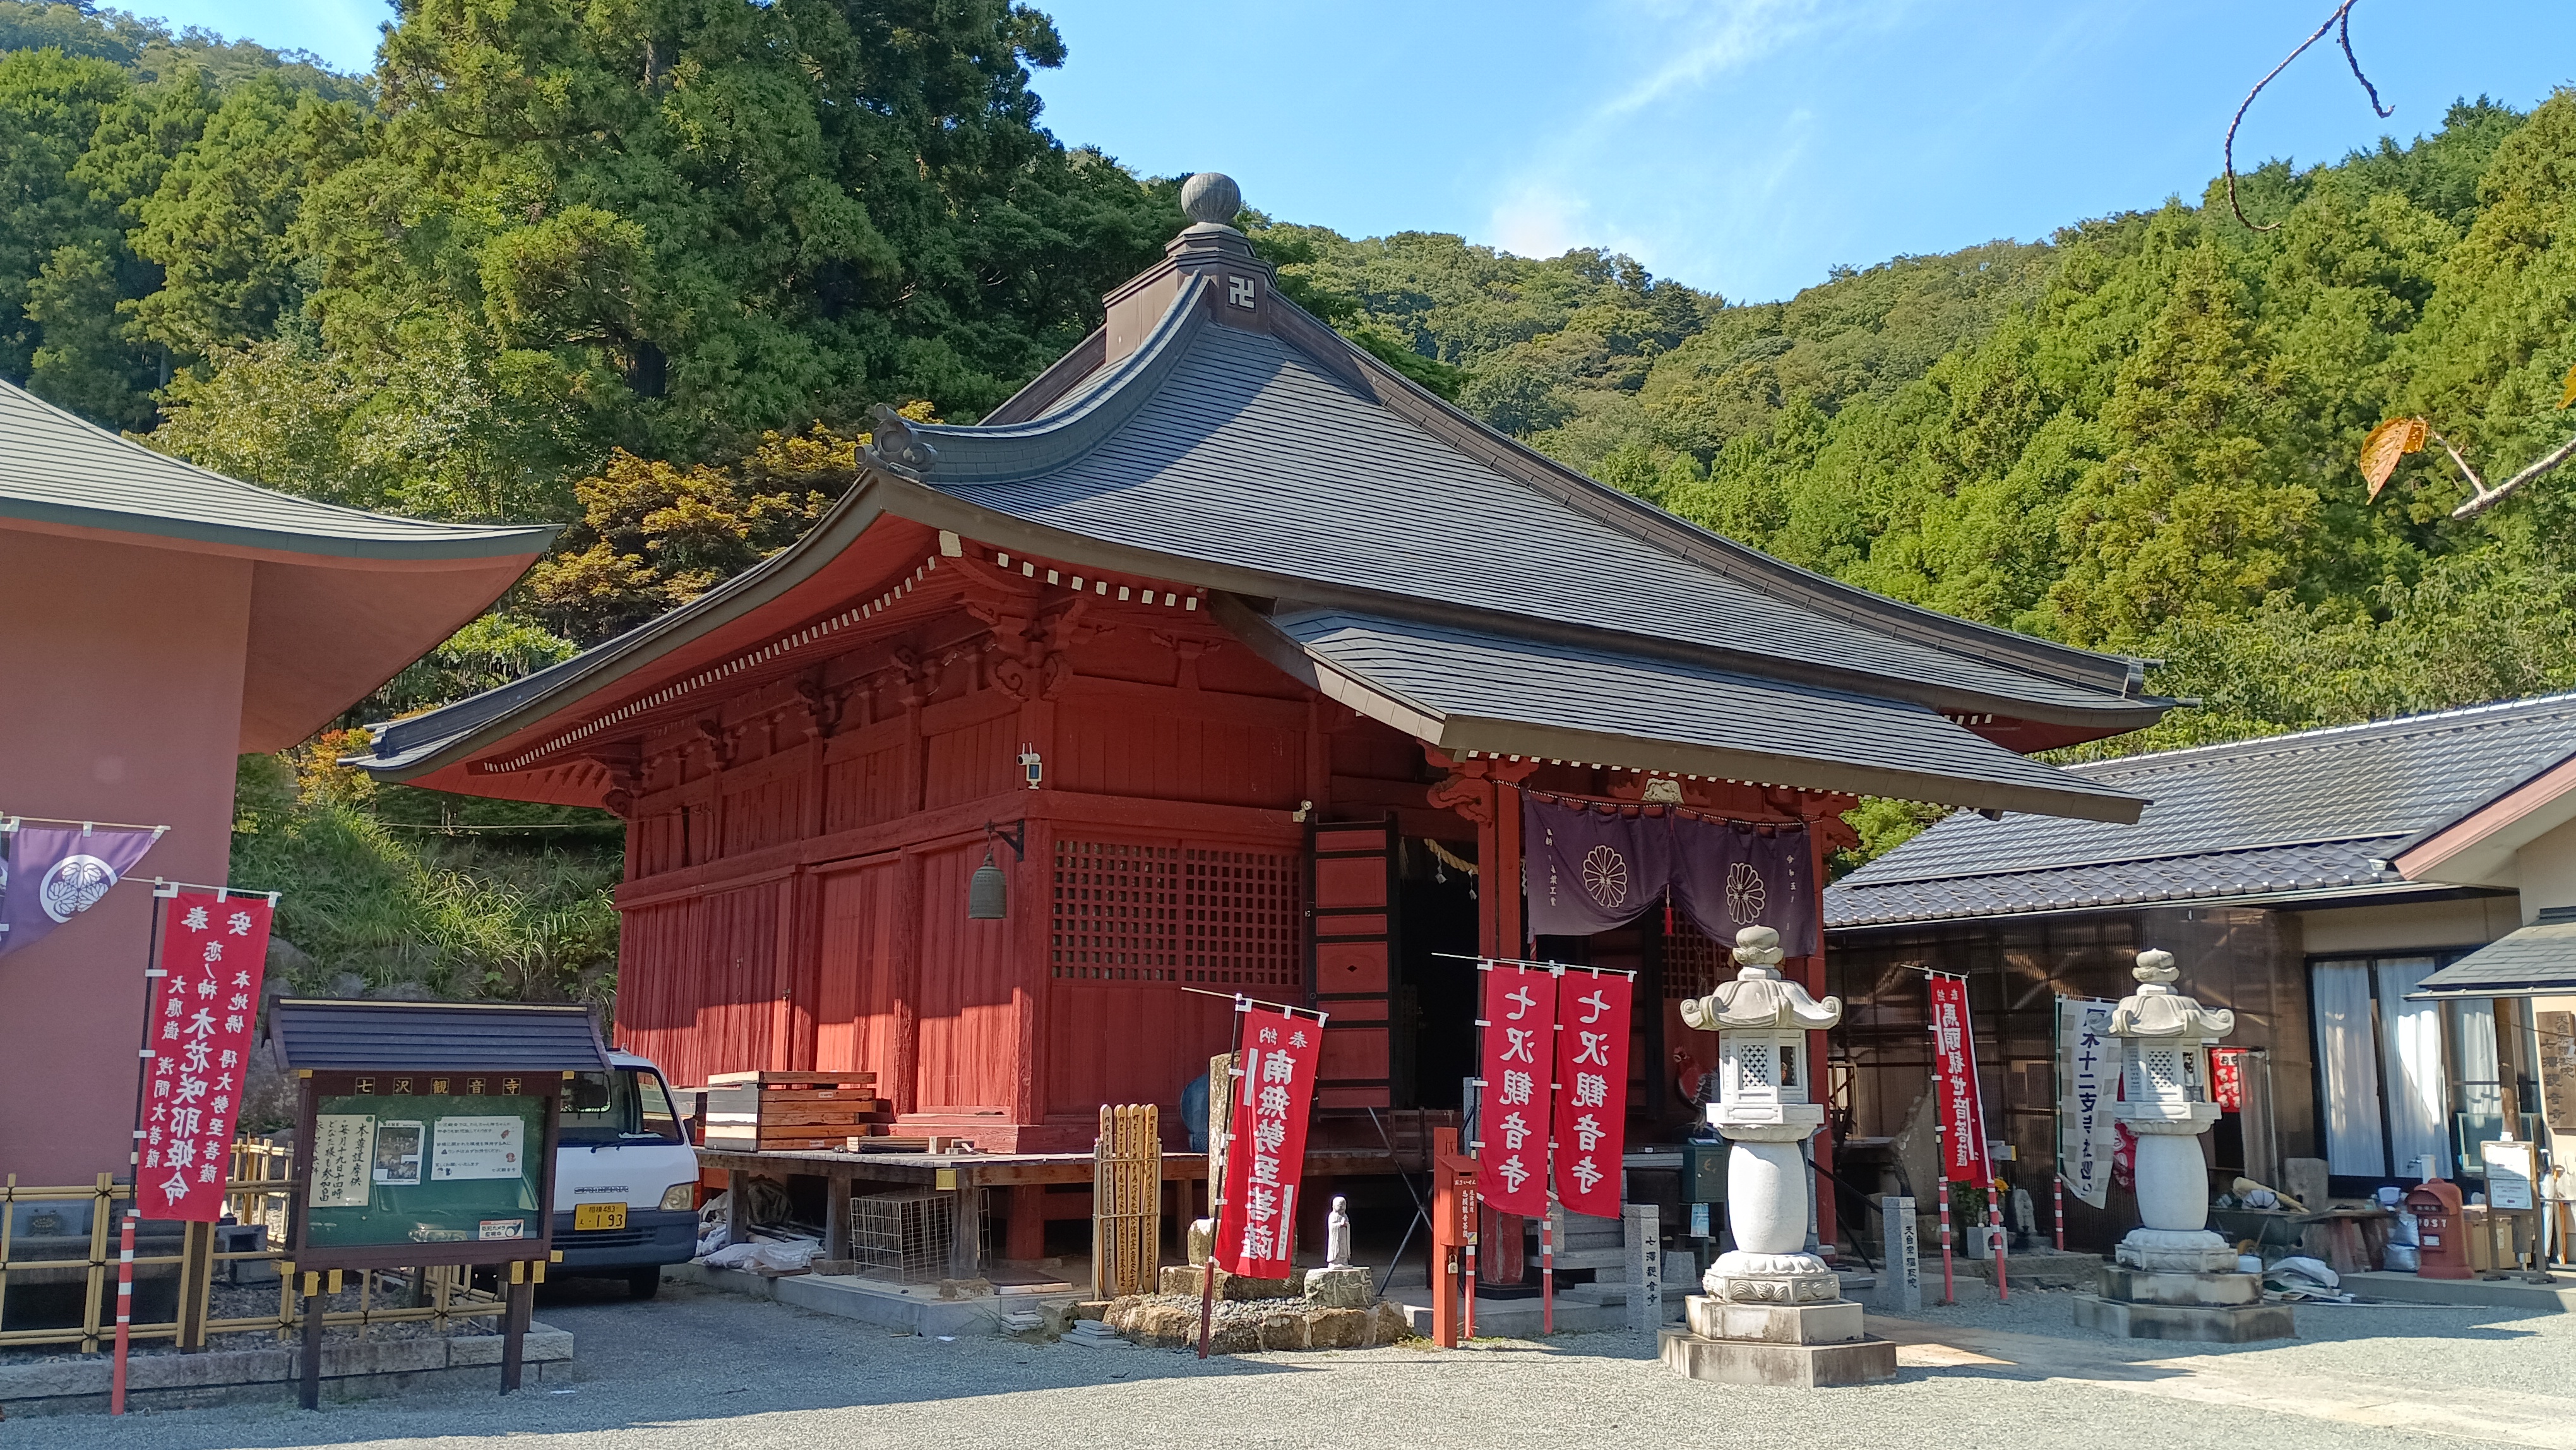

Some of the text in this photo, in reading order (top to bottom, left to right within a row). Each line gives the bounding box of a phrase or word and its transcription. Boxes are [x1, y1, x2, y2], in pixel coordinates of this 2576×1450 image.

[357, 1079, 520, 1094] 七沢観音寺
